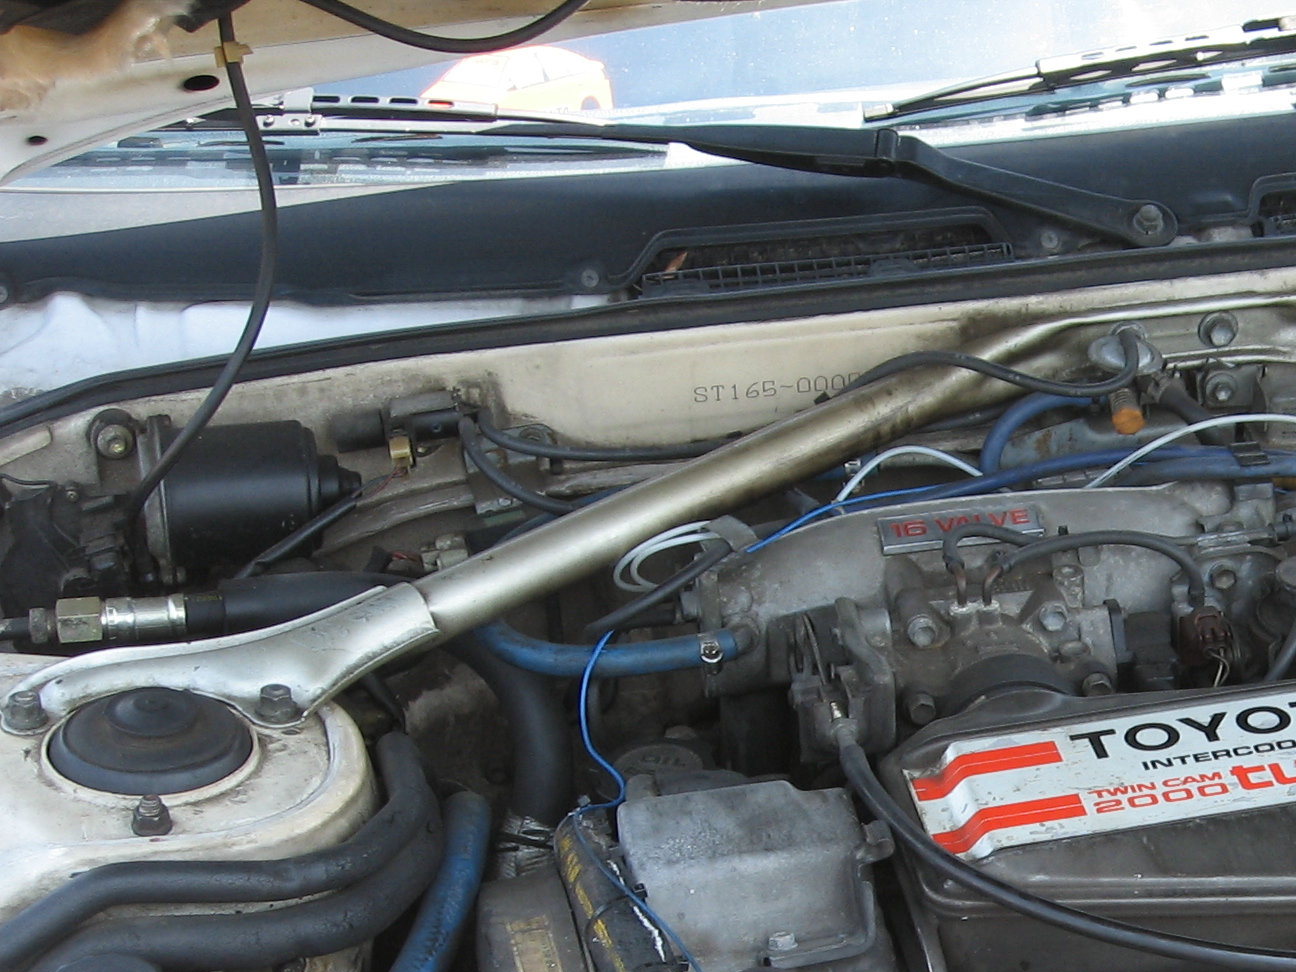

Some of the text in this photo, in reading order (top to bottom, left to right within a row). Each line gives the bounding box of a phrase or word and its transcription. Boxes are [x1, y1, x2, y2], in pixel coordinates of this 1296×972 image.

[890, 519, 928, 538] 16
[1088, 772, 1222, 798] TWIN CAM
[1093, 782, 1230, 814] 2000
